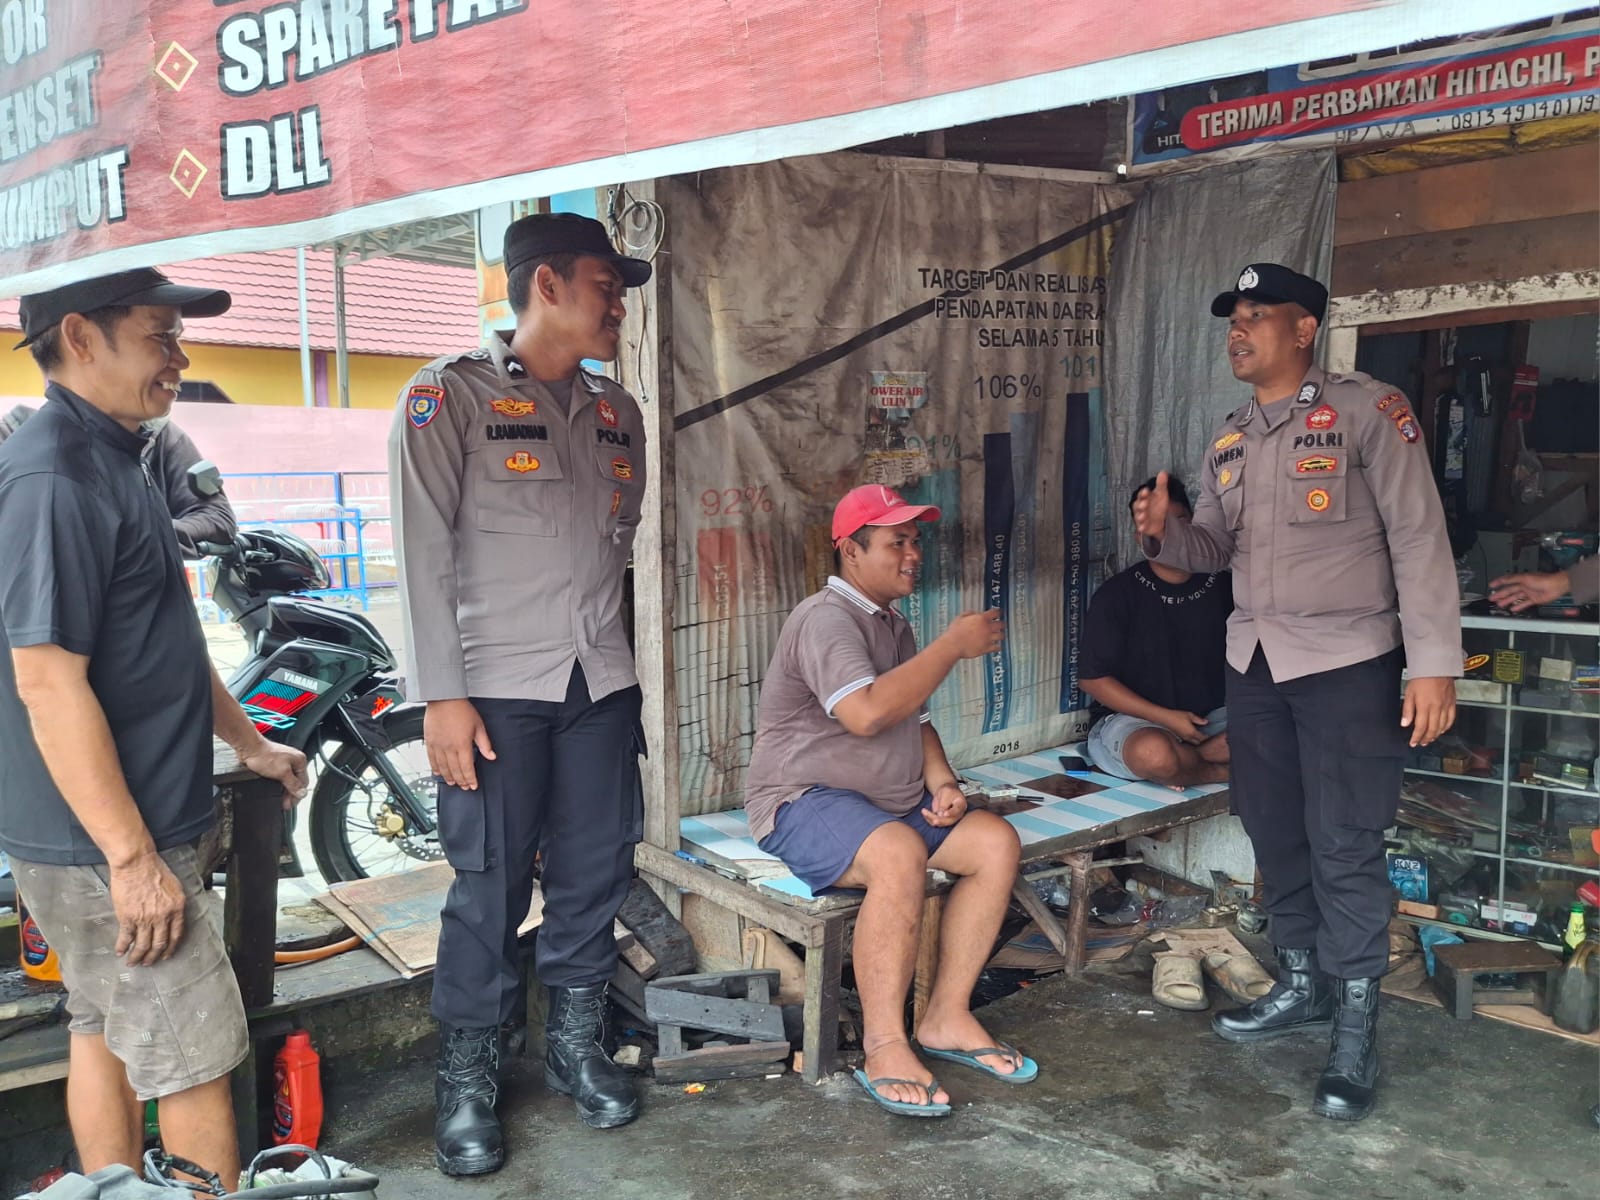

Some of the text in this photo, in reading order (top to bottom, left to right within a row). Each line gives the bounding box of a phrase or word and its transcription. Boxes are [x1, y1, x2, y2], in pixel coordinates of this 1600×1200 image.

[1197, 101, 1283, 139] TERIMA
[1292, 74, 1438, 122] PERBAIKAN
[1446, 50, 1574, 98] HITACHI,
[1157, 133, 1183, 147] HIT
[223, 107, 330, 198] DLL
[918, 267, 989, 290] TARGET
[995, 270, 1030, 291] DAN
[935, 298, 1048, 320] PENDAPATAN
[978, 328, 1049, 348] SELAMA
[1051, 329, 1058, 348] 5
[973, 373, 1042, 400] 106%
[1294, 432, 1342, 449] POLRI
[700, 484, 774, 517] 92%
[282, 671, 319, 691] YAMAHA
[993, 740, 1020, 755] 2018
